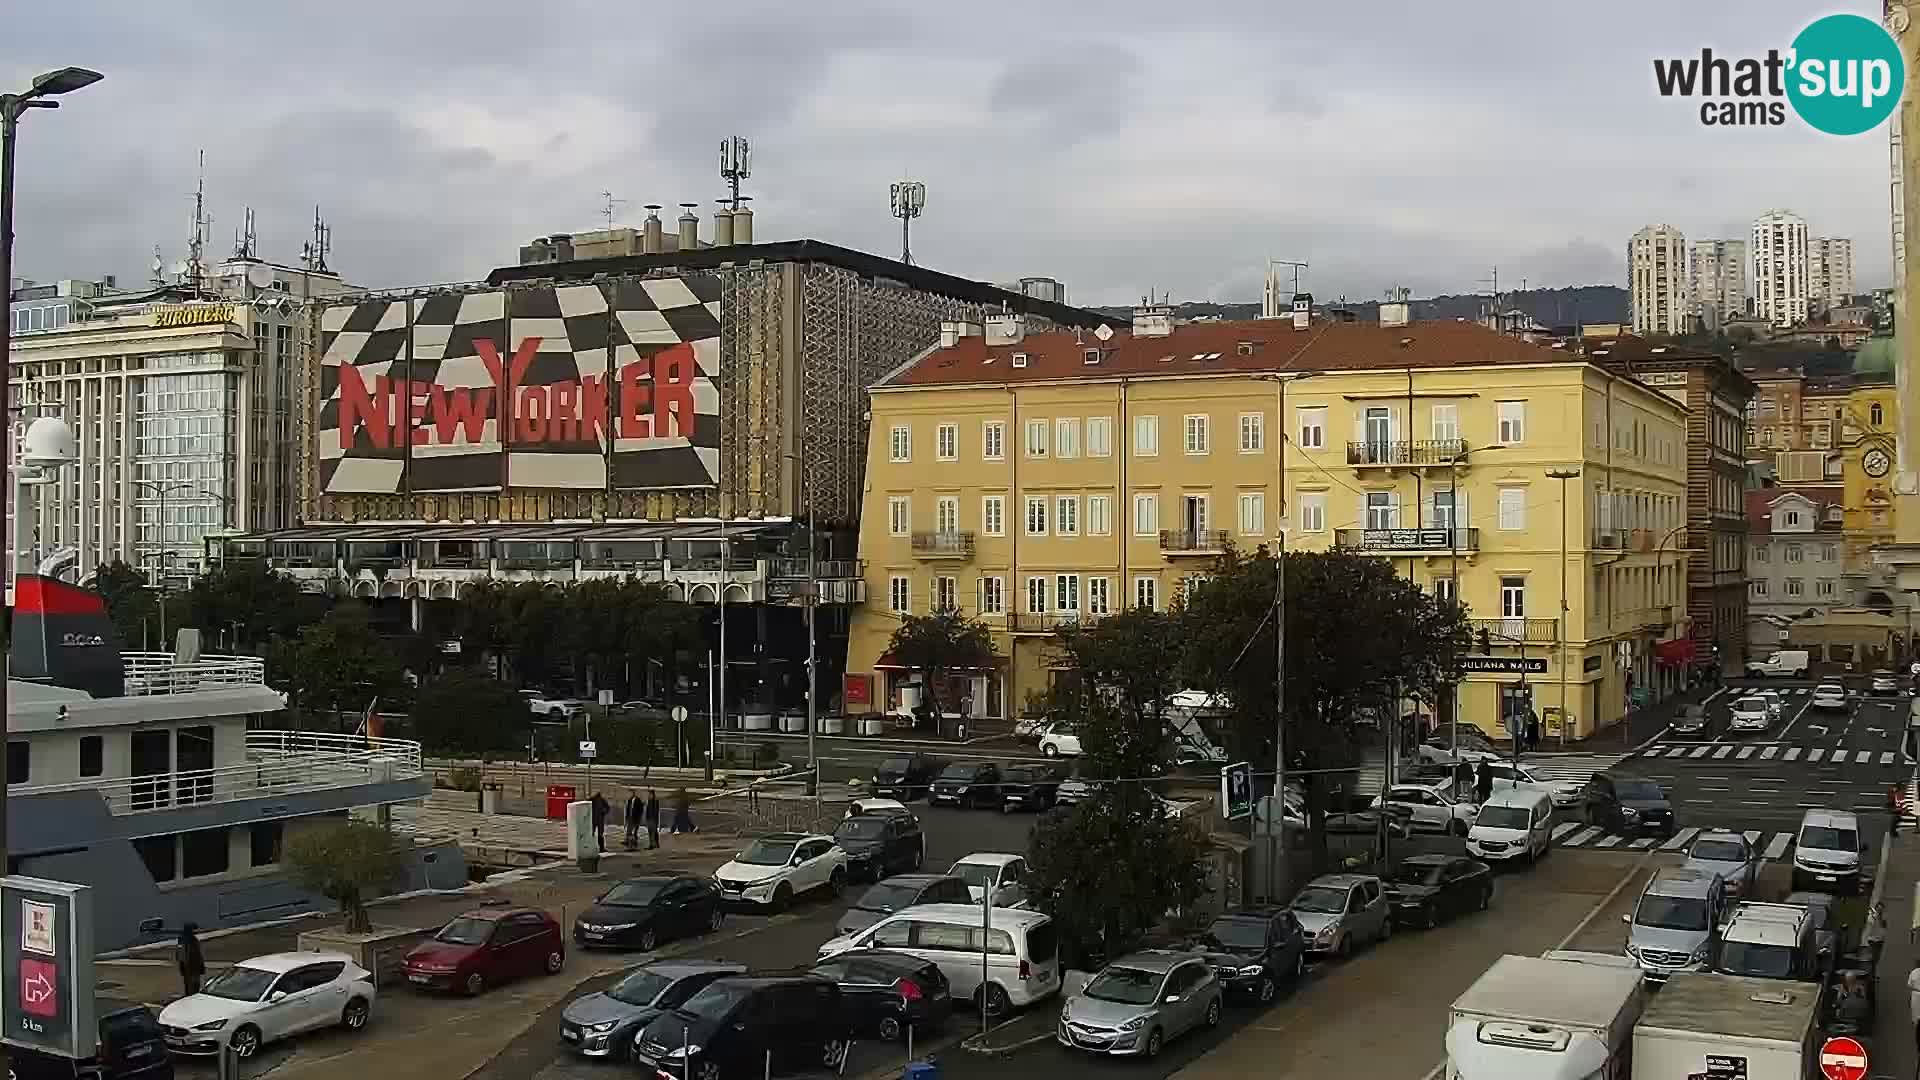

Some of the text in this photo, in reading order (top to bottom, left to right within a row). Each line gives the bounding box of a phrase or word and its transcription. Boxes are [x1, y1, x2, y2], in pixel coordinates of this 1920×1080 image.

[1460, 661, 1542, 670] JULIANA NAILS
[30, 1019, 43, 1033] km
